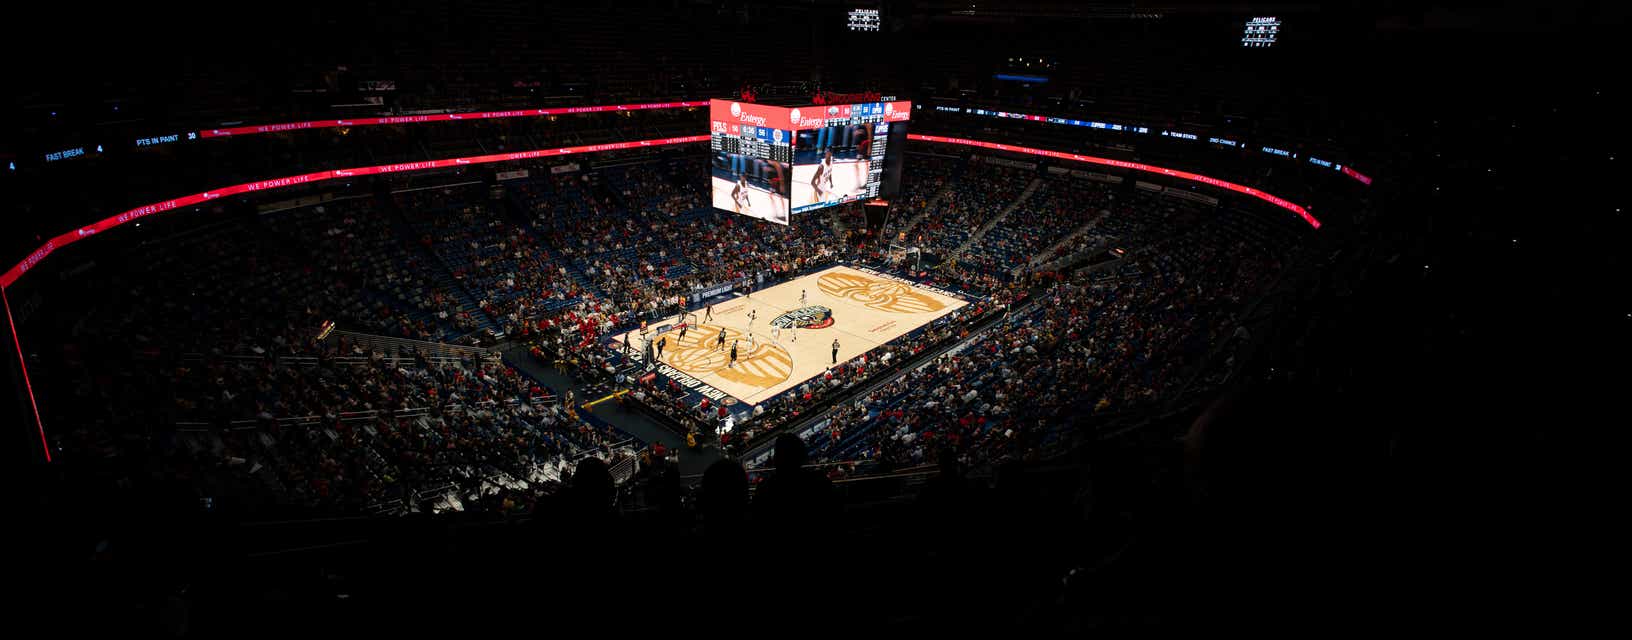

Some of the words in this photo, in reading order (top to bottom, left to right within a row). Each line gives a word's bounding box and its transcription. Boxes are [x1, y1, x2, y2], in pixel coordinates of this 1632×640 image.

[136, 138, 151, 146] PTS
[160, 134, 179, 143] PAINT
[45, 152, 61, 162] FAST
[63, 147, 85, 159] BREAK
[395, 163, 419, 171] POWER
[263, 179, 291, 188] POWER
[294, 176, 309, 184] LIFE
[130, 206, 156, 219] POWER
[658, 365, 702, 388] ORLEANS
[694, 385, 727, 401] NEW
